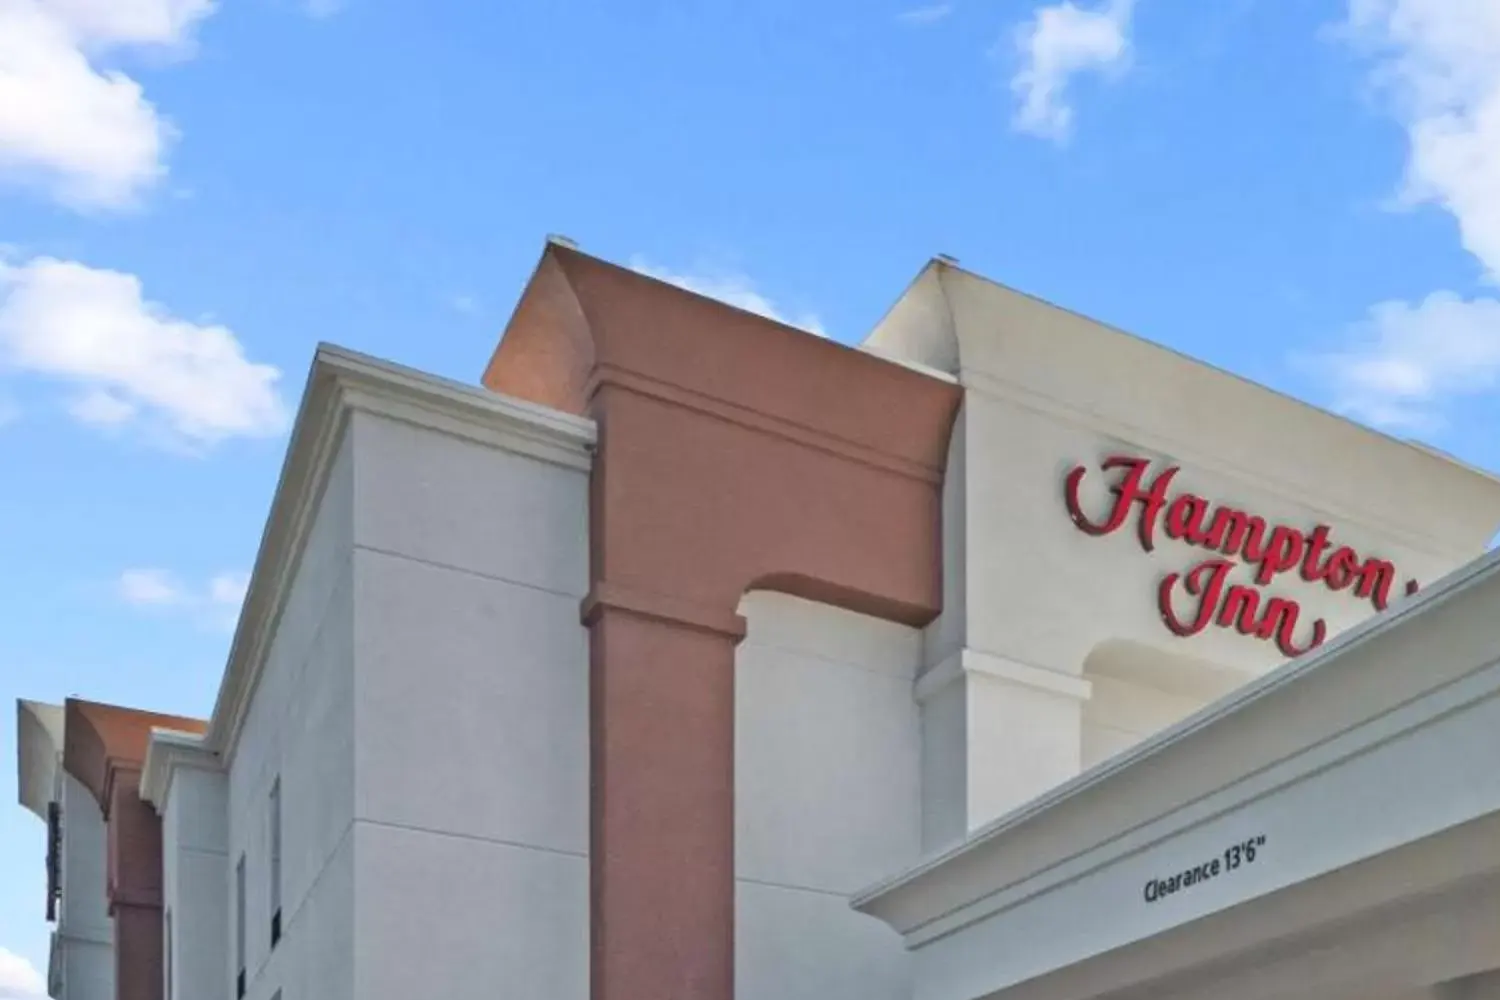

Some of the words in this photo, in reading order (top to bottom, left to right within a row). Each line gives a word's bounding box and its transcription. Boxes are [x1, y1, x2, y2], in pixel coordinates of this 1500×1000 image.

[1064, 455, 1419, 612] Hampton
[1157, 559, 1327, 658] Inn
[1143, 857, 1221, 903] Clearance
